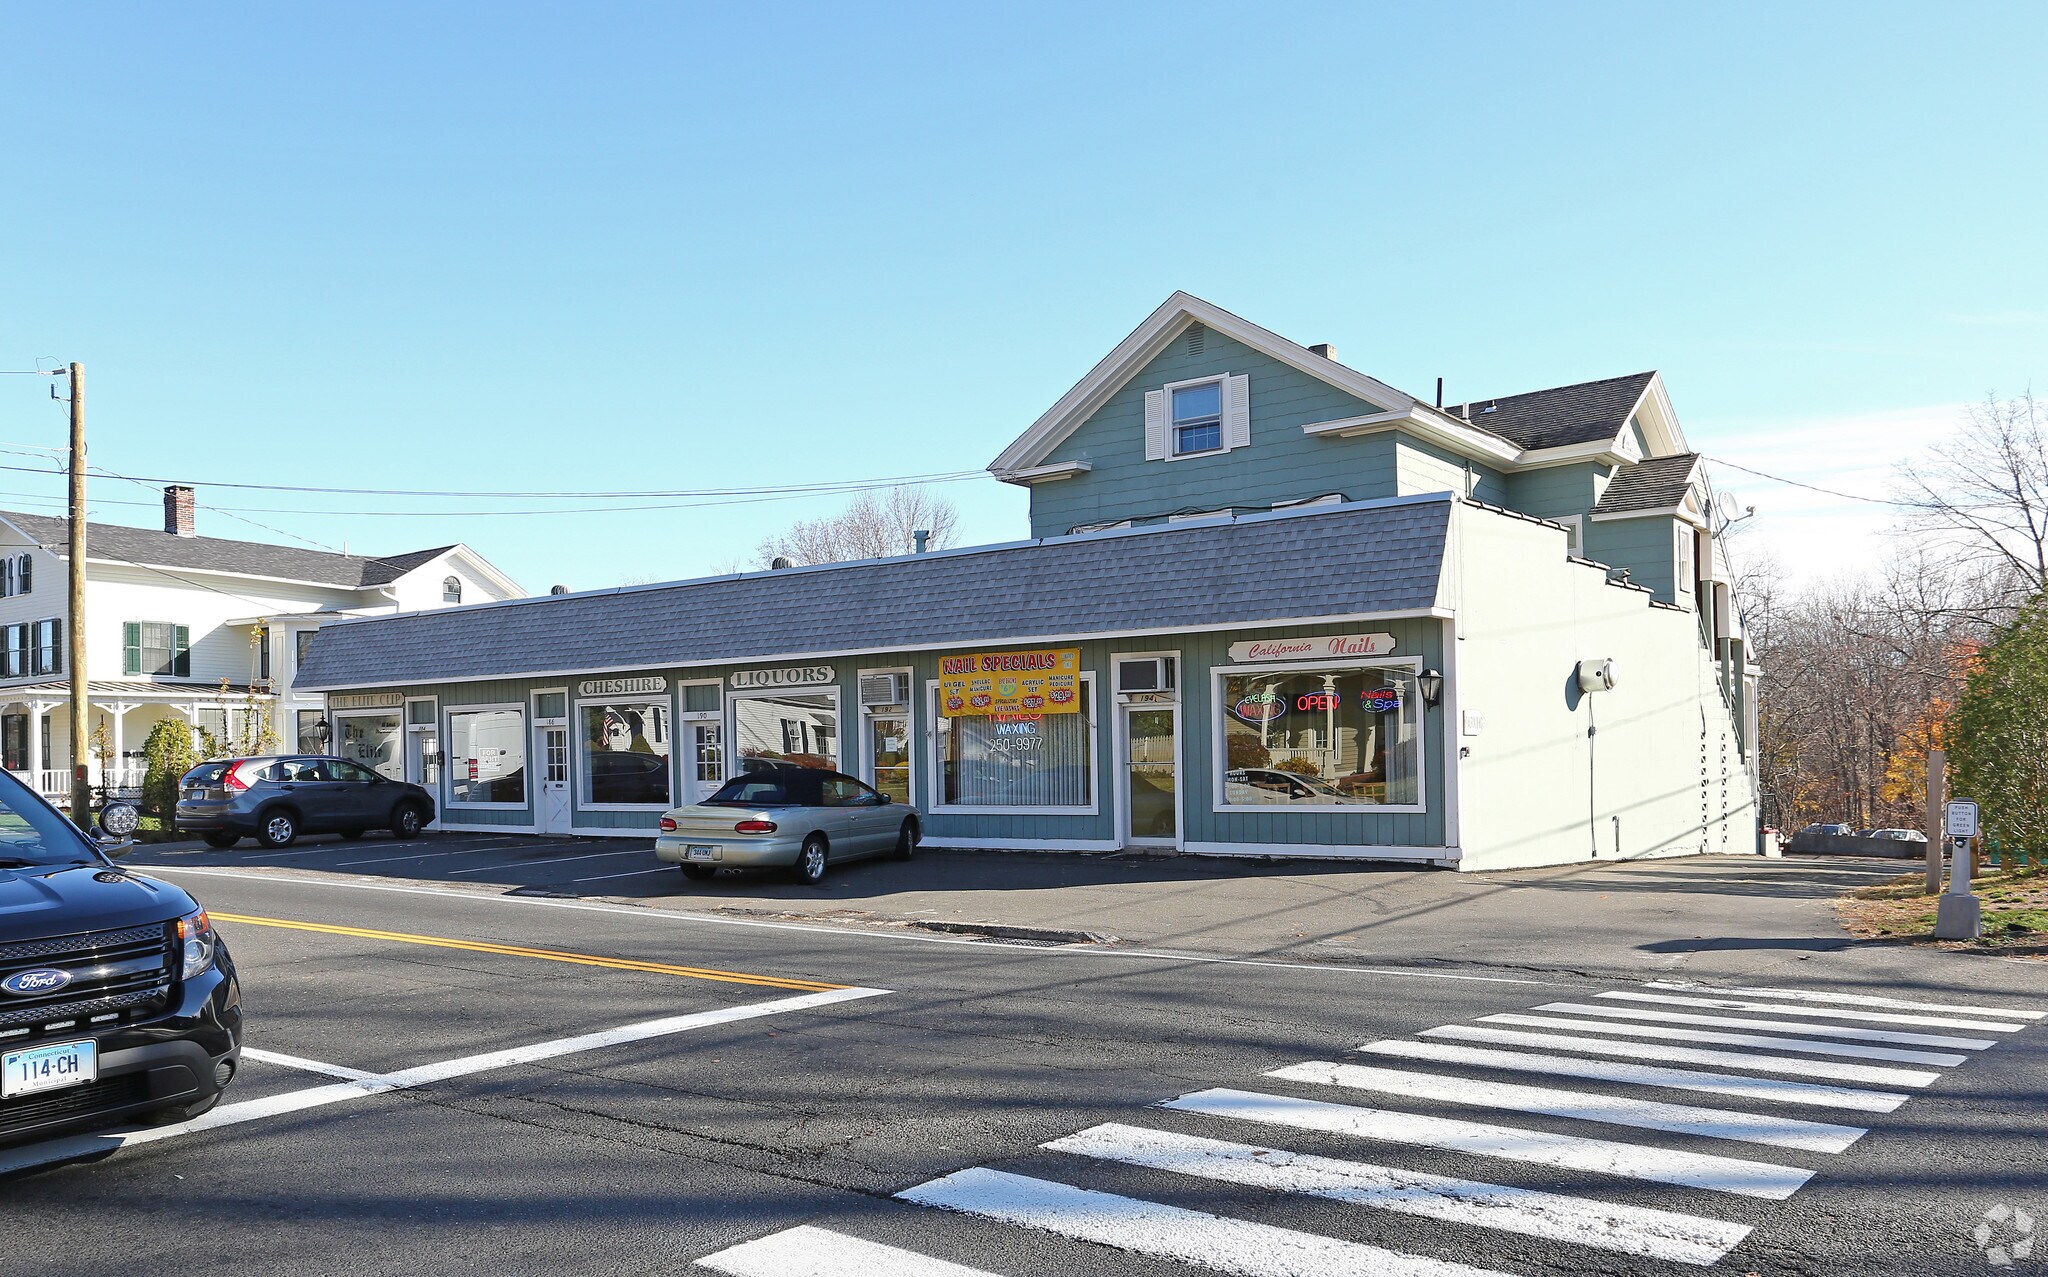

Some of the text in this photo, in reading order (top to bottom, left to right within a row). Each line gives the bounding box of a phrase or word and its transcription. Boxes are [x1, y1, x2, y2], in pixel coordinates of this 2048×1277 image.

[1248, 637, 1377, 658] California Nails
[943, 653, 1056, 675] NAIL SPECIALS
[735, 666, 828, 687] LIQUORS
[582, 677, 663, 694] CHESHIRE
[332, 694, 401, 707] THE ELITE CLIP
[1244, 693, 1276, 704] EYELASH
[1360, 690, 1393, 699] Nails
[1297, 695, 1340, 710] OPEN
[1364, 698, 1402, 709] & Spa
[1239, 703, 1281, 717] WAXNG
[995, 722, 1036, 735] WAXING
[990, 737, 1043, 751] 250-9977
[19, 972, 56, 989] Ford
[28, 1048, 70, 1060] Connecticut
[32, 1076, 67, 1087] Municipal
